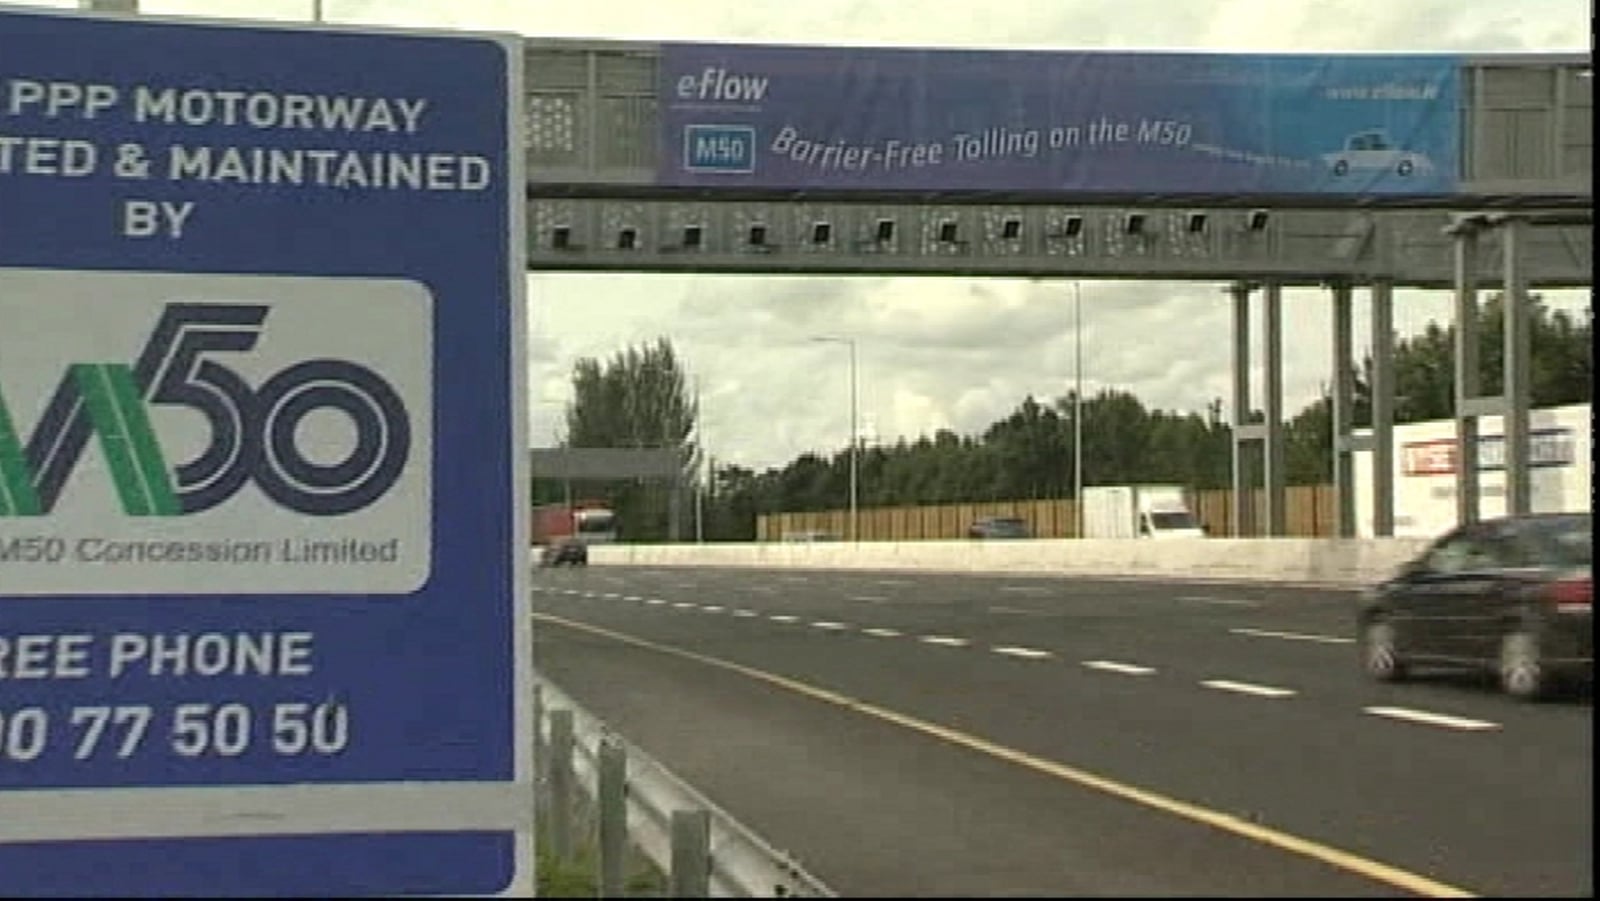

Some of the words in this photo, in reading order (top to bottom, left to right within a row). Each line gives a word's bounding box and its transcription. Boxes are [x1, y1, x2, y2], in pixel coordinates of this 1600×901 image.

[9, 80, 118, 120] PPP
[134, 86, 426, 133] MOTORWAY
[0, 137, 96, 177] TED
[114, 143, 151, 180] &
[170, 146, 491, 191] MAINTAINED
[770, 125, 943, 172] Barrier-Free
[952, 126, 1040, 161] Tolling
[1049, 123, 1080, 149] on
[1088, 116, 1129, 144] the
[1137, 119, 1193, 146] M50
[123, 201, 194, 239] BY
[0, 538, 65, 564] M50
[75, 537, 271, 564] Concession
[282, 536, 399, 563] Limited
[109, 632, 314, 678] PHONE
[72, 706, 152, 760] 77
[172, 703, 250, 757] 50
[272, 702, 349, 755] 50
